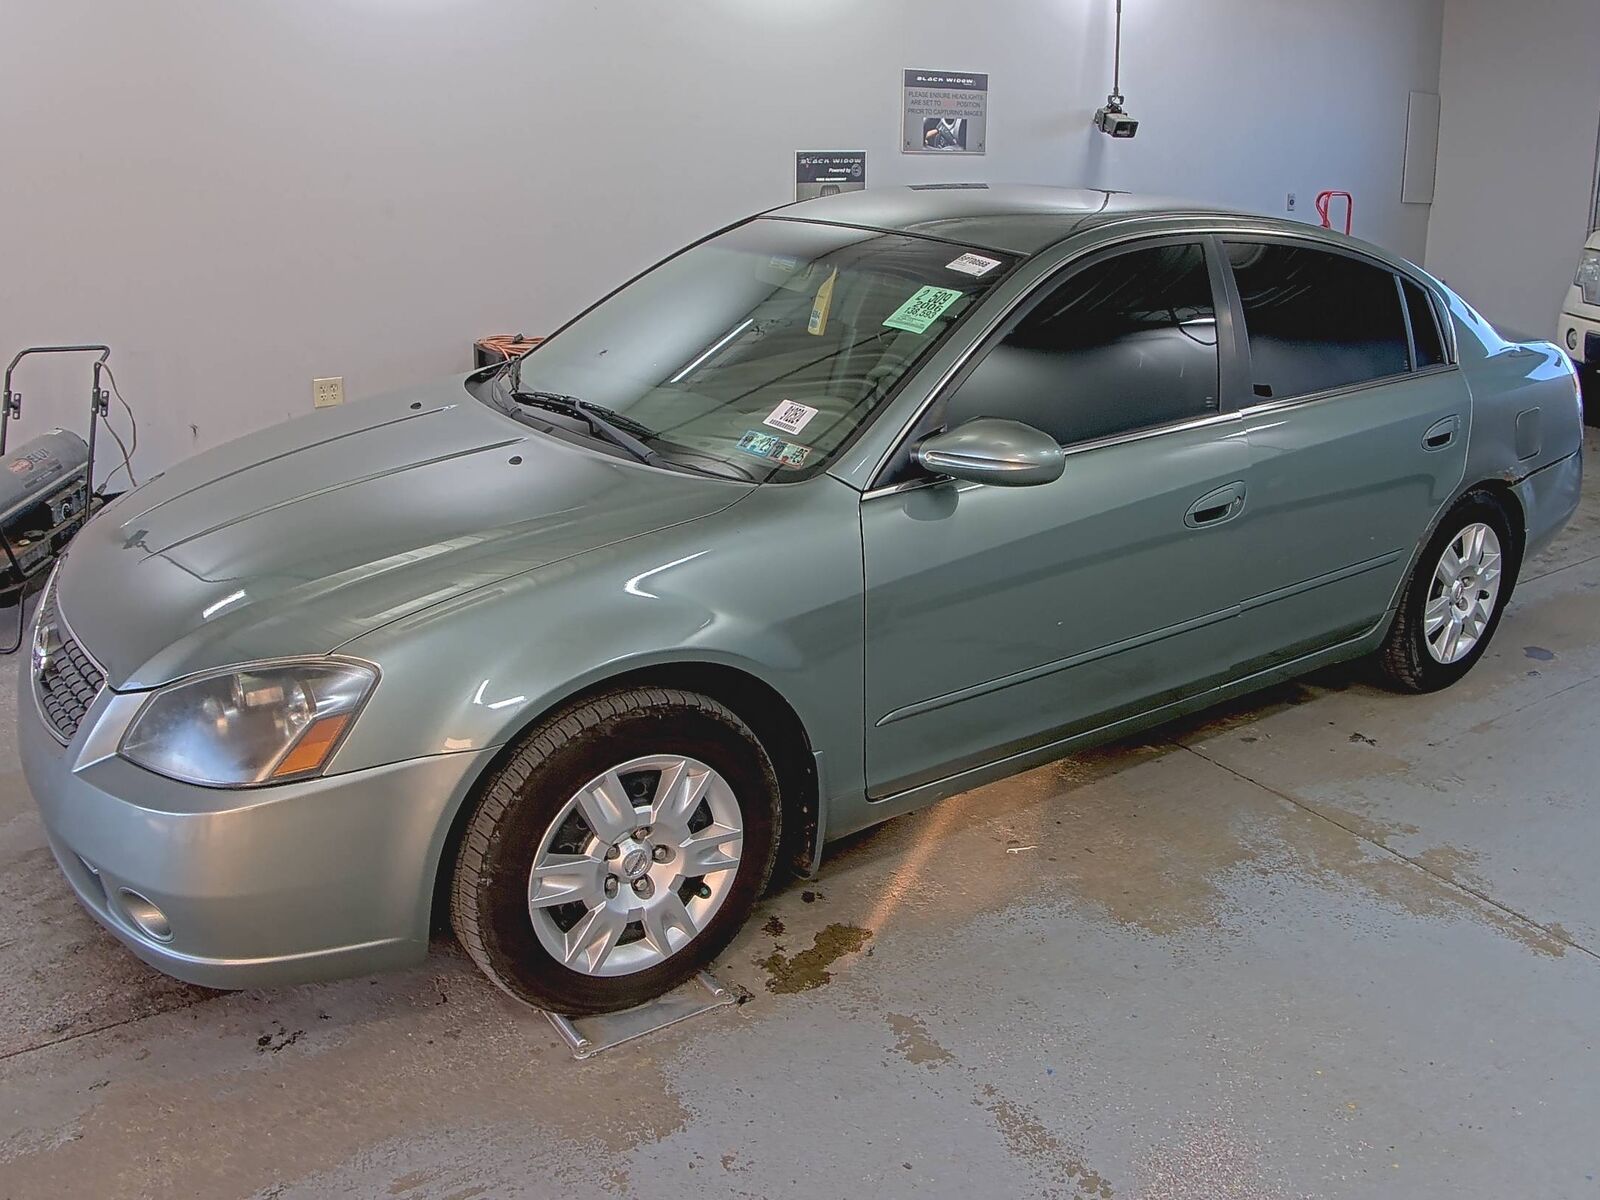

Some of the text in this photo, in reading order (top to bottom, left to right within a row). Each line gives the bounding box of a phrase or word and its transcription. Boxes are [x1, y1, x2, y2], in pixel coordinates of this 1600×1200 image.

[928, 290, 953, 306] 509
[914, 301, 943, 312] 2006
[904, 307, 937, 319] 138,593
